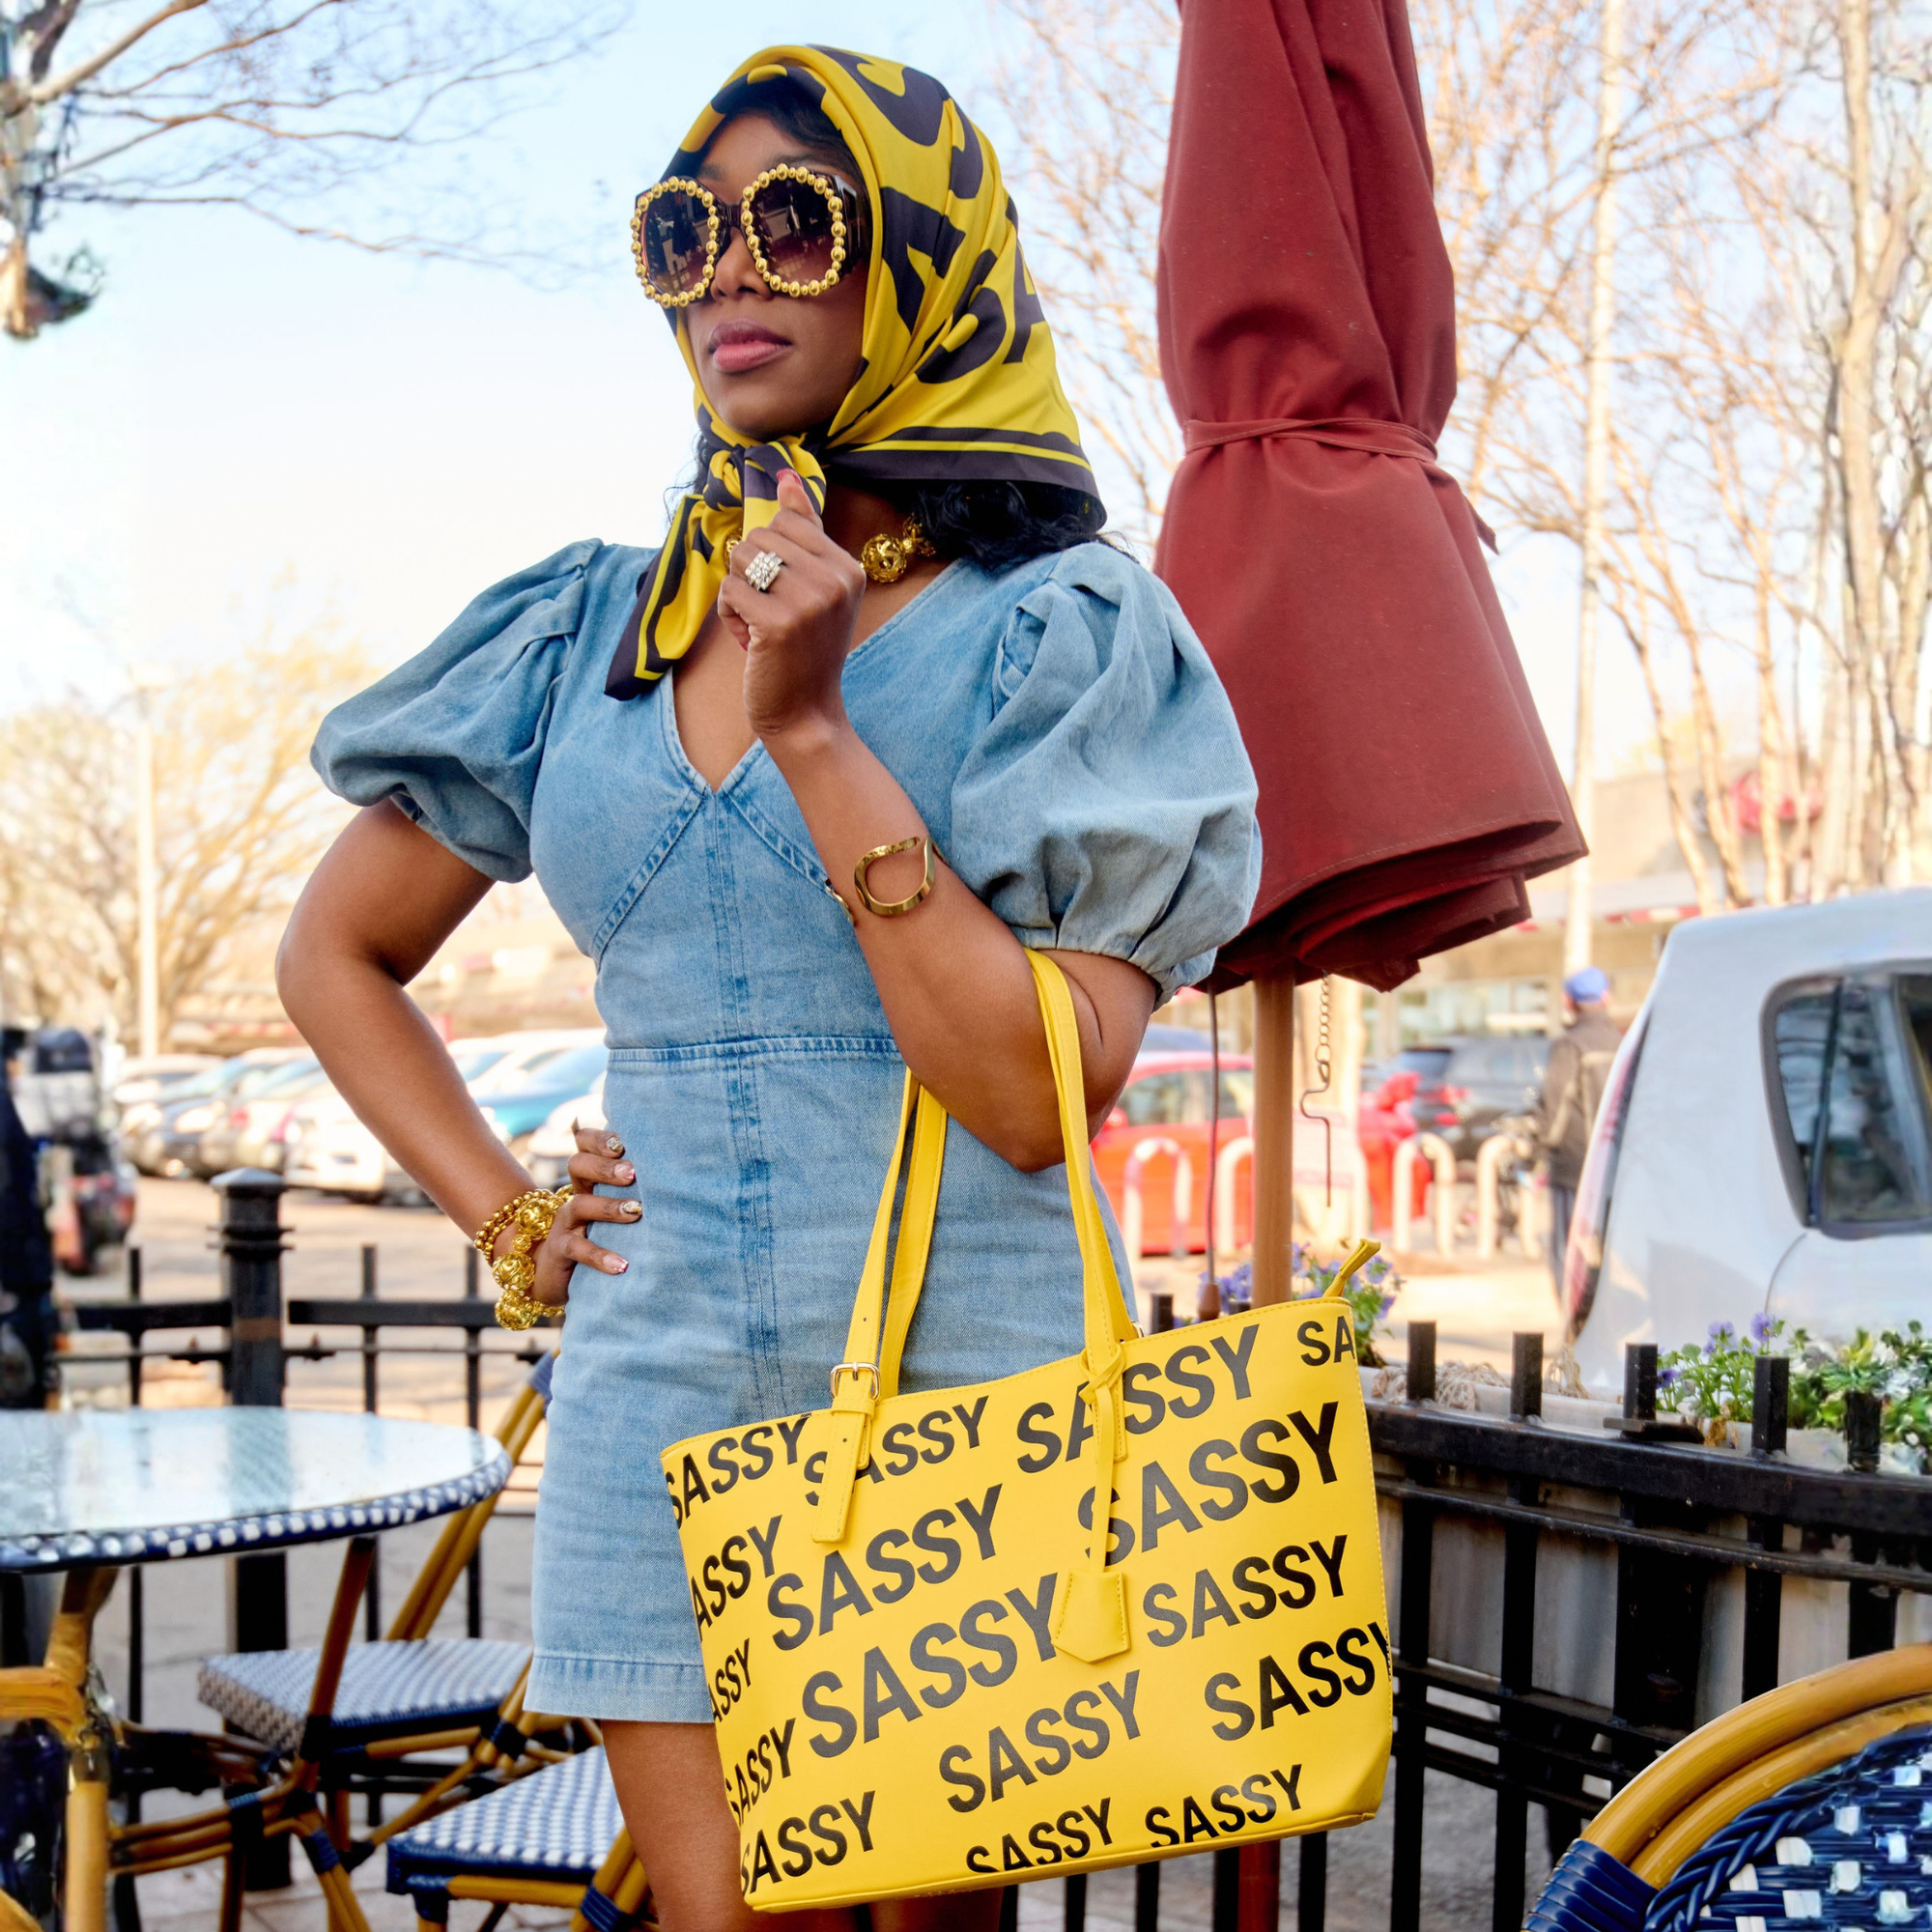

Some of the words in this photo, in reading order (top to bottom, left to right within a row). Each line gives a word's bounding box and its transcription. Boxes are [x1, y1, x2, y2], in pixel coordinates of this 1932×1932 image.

[1078, 1402, 1339, 1567] SASSY
[768, 1484, 1003, 1651] SASSY
[1143, 1535, 1348, 1647] SASSY
[803, 1573, 1058, 1758] SASSY
[939, 1669, 1141, 1813] SASSY
[1145, 1764, 1302, 1848] SASSY
